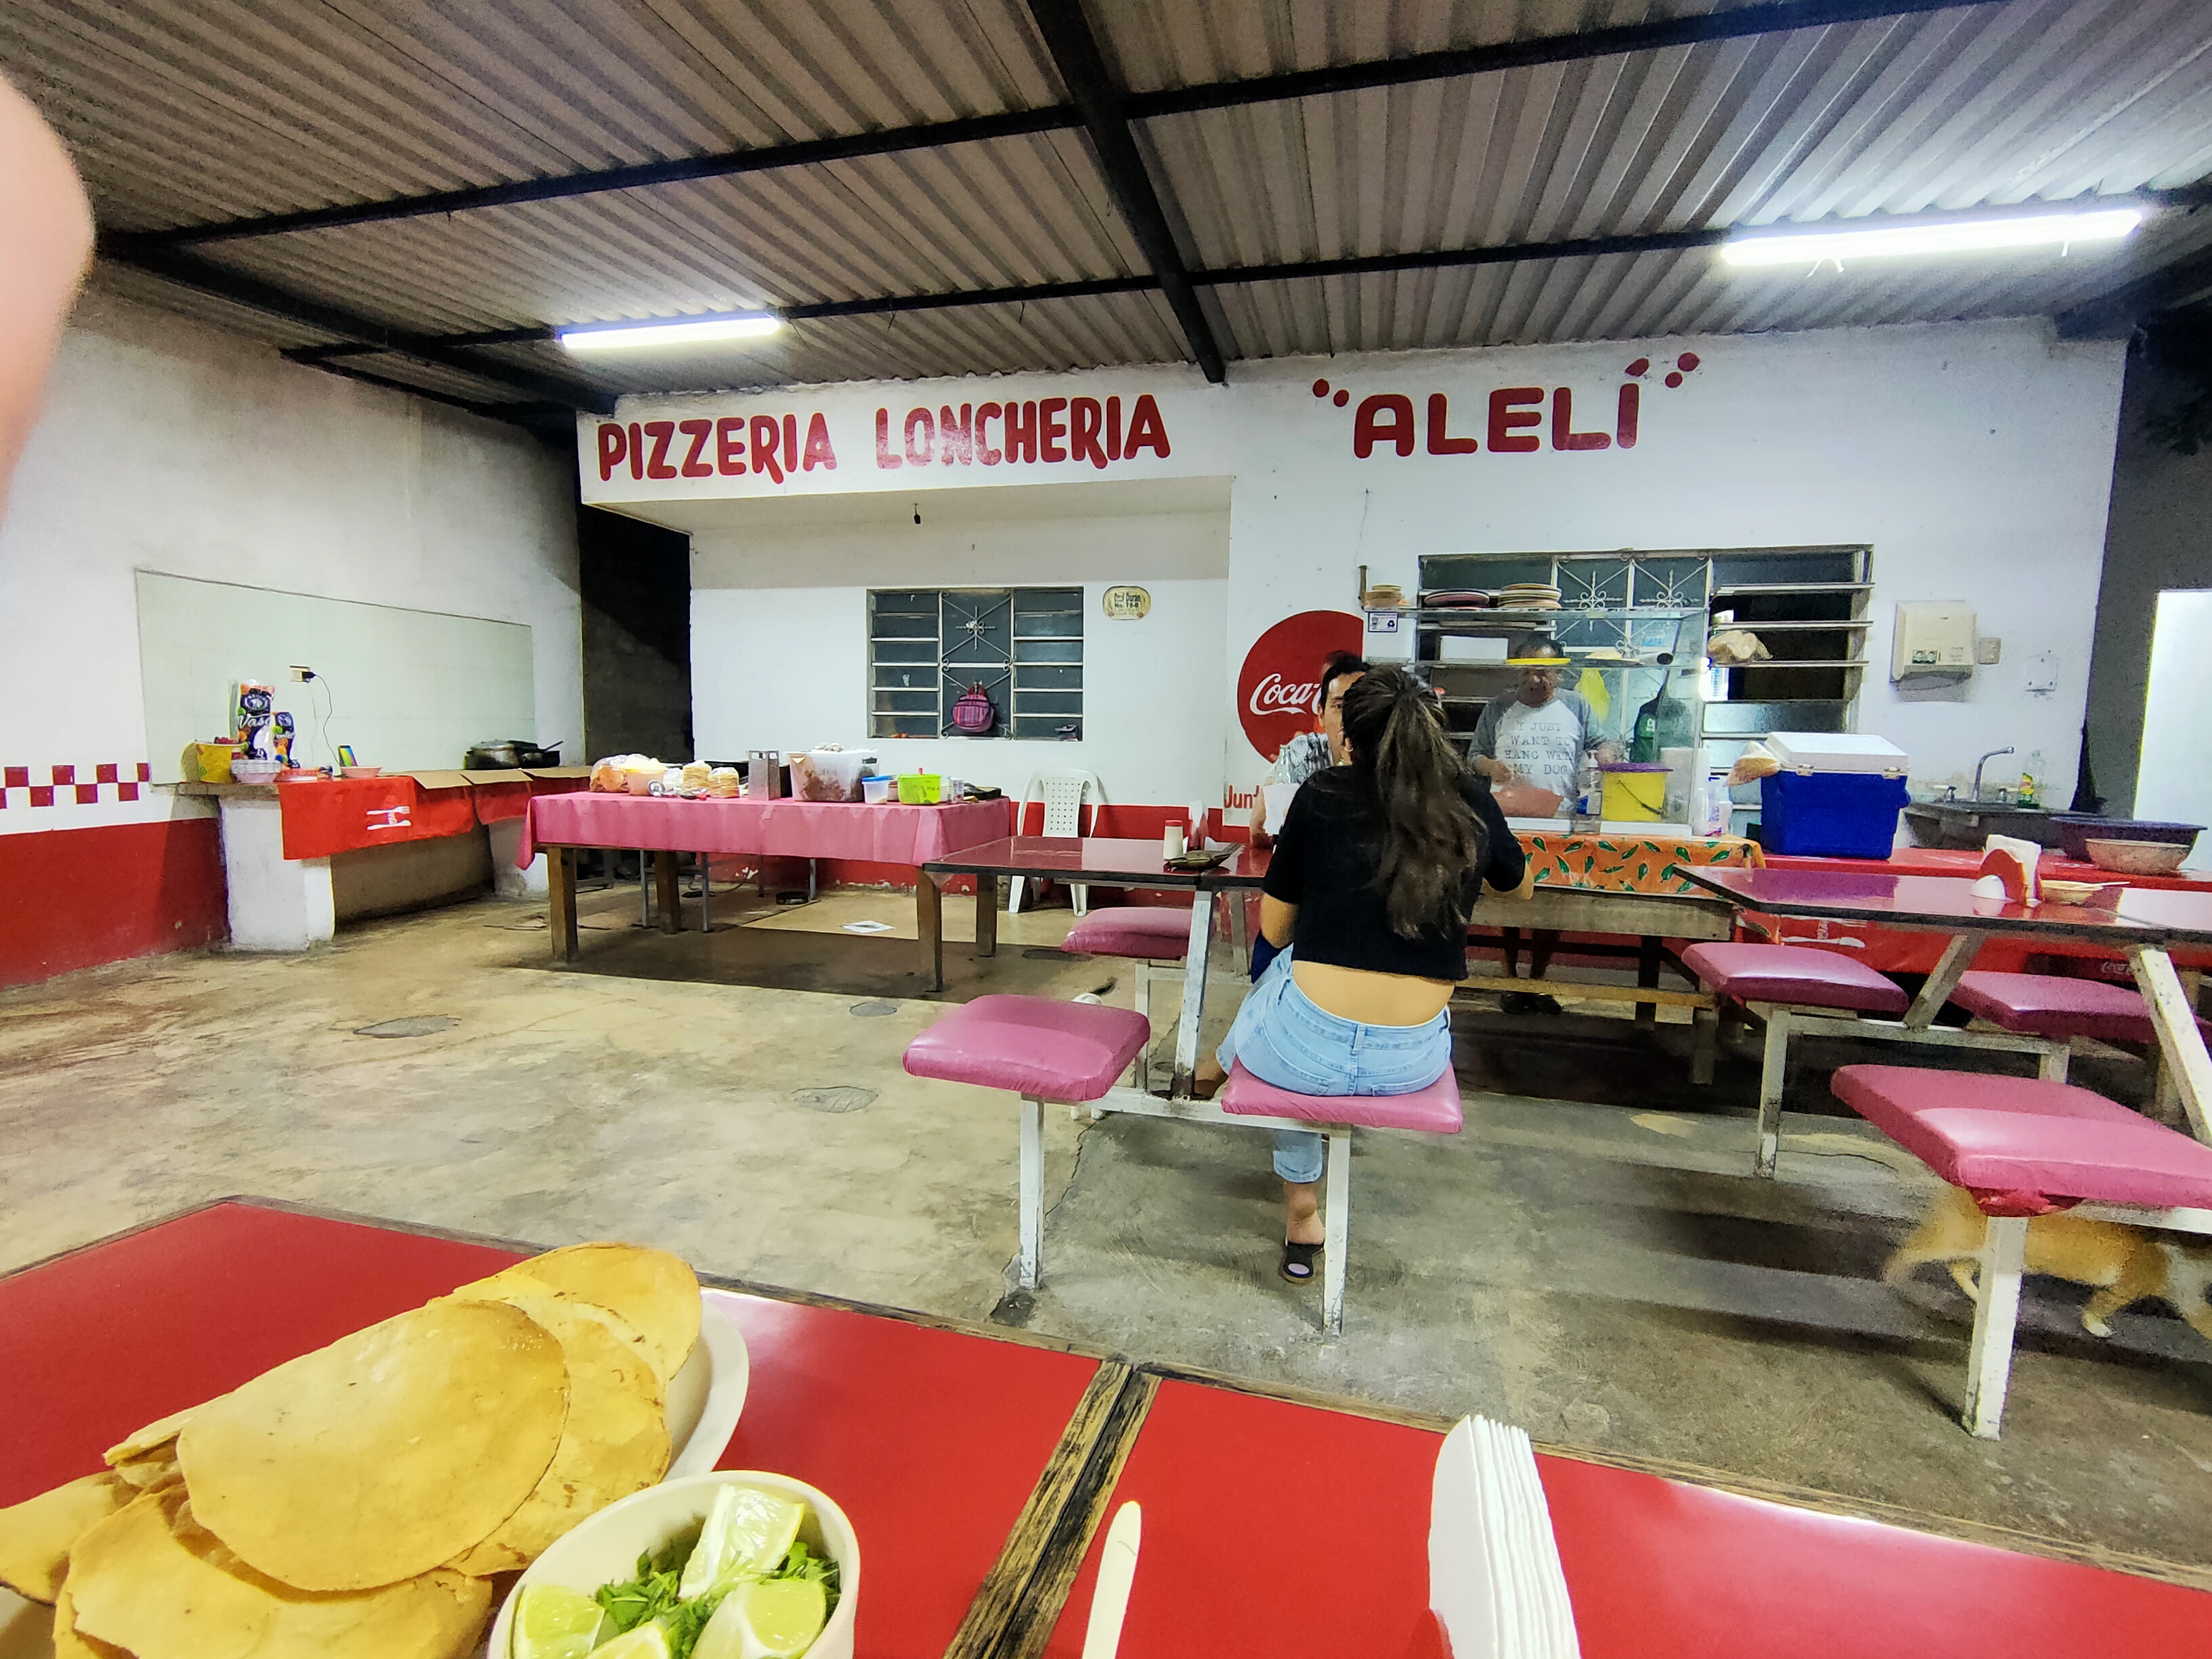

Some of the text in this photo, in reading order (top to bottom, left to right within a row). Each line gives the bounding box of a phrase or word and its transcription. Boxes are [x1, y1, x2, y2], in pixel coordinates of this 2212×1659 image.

[598, 393, 1171, 485] PIZZERIA LONCHERIA
[1250, 673, 1321, 716] Coca-
[1530, 722, 1561, 732] JUST
[1511, 735, 1571, 746] WANT TO
[1504, 750, 1540, 760] HANG
[1513, 764, 1568, 775] MY DOG
